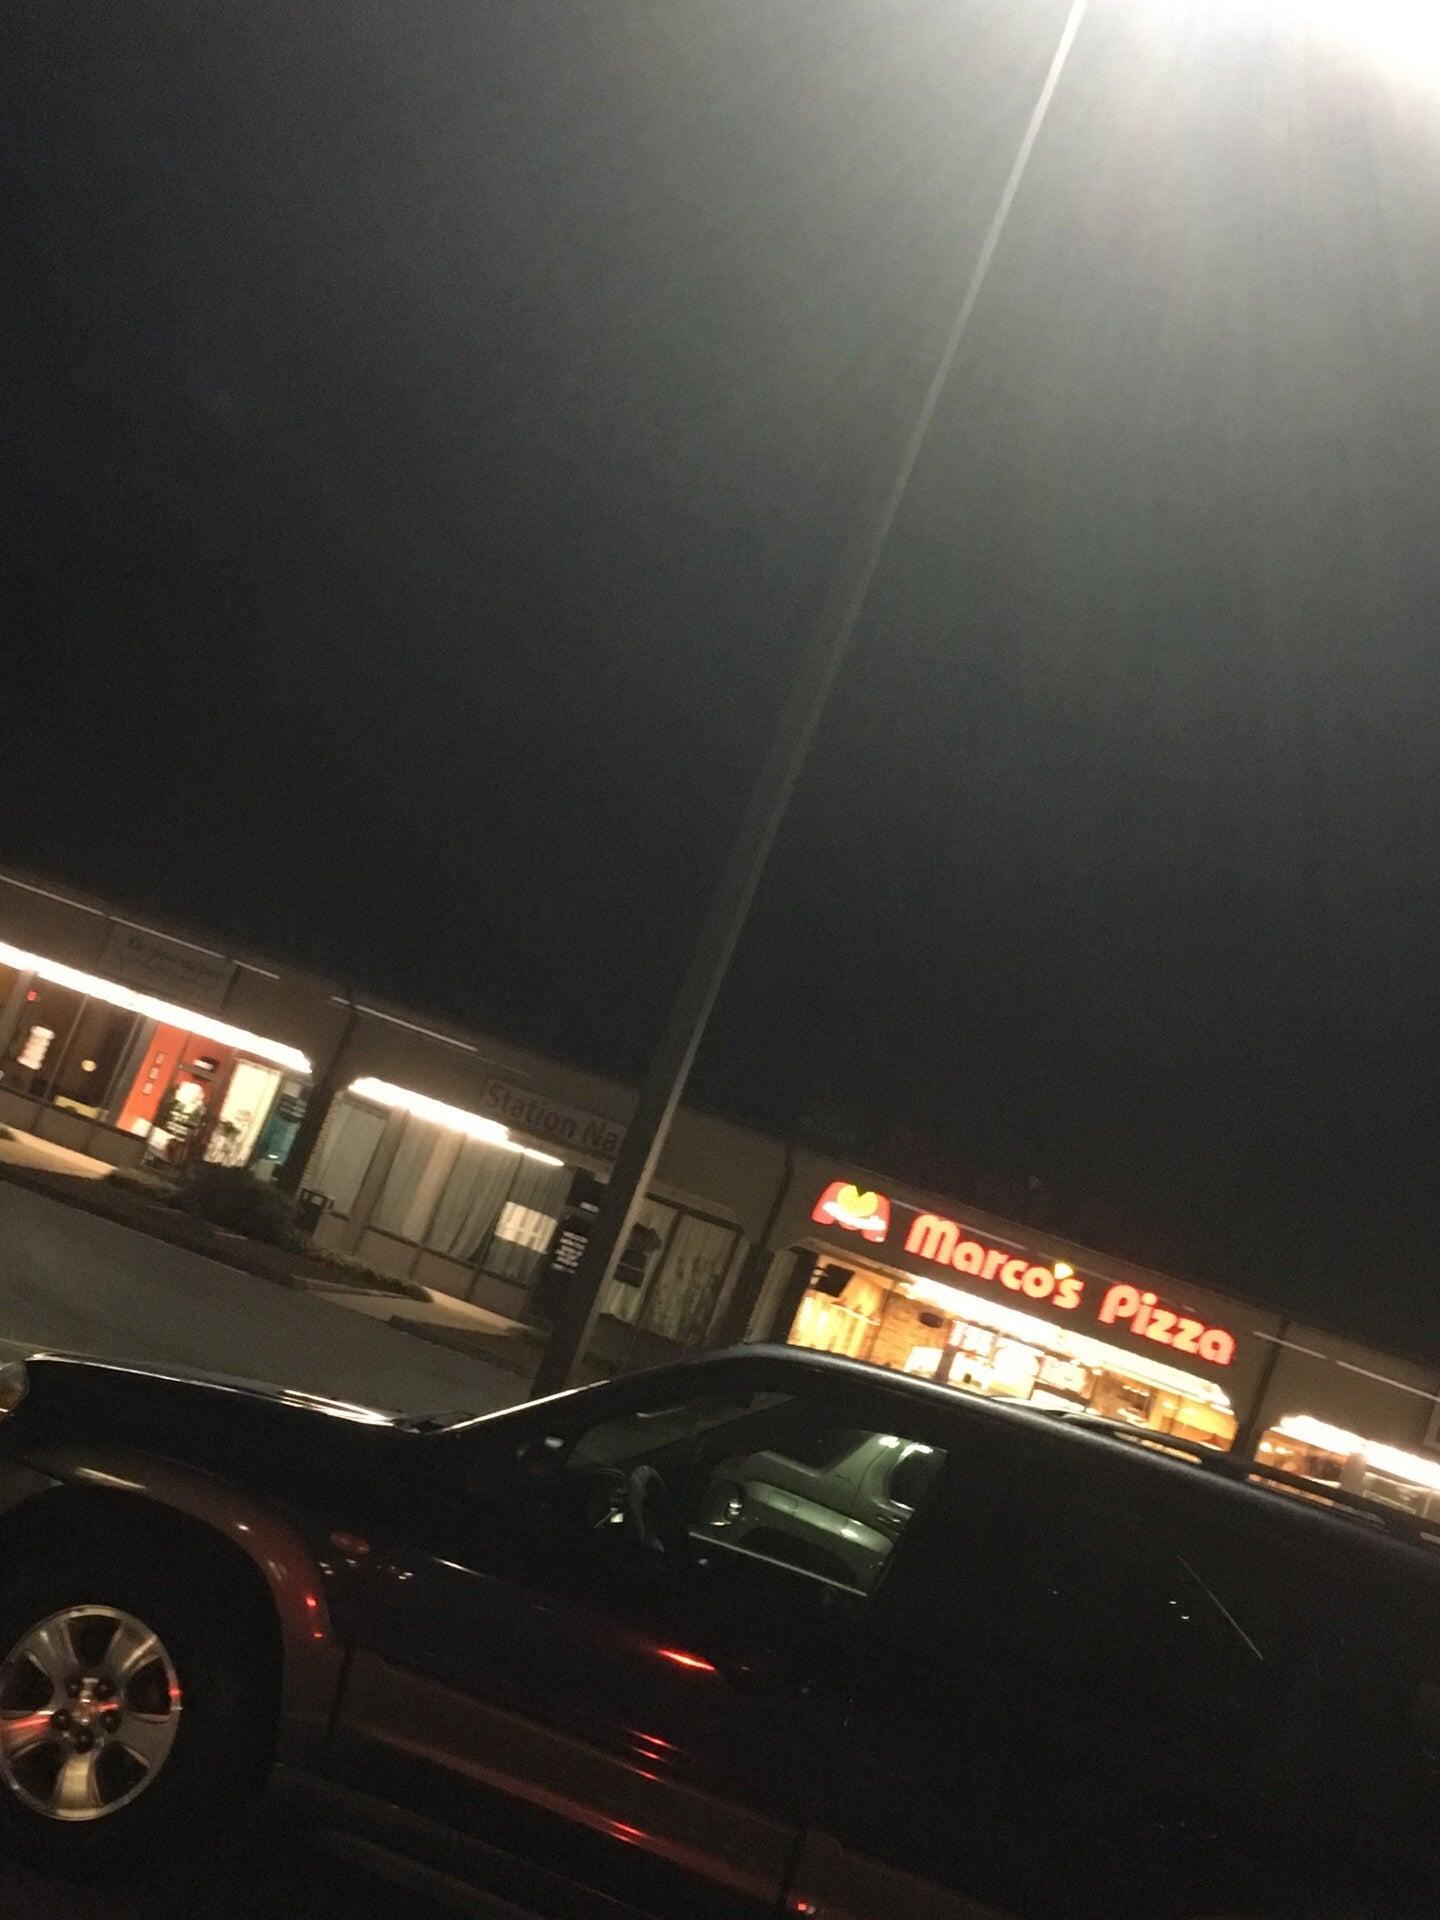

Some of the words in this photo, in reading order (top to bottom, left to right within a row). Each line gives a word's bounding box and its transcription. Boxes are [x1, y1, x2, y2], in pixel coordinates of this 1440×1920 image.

[485, 1082, 578, 1140] Station
[904, 1212, 1085, 1310] Marco's
[1098, 1283, 1237, 1366] Pizza
